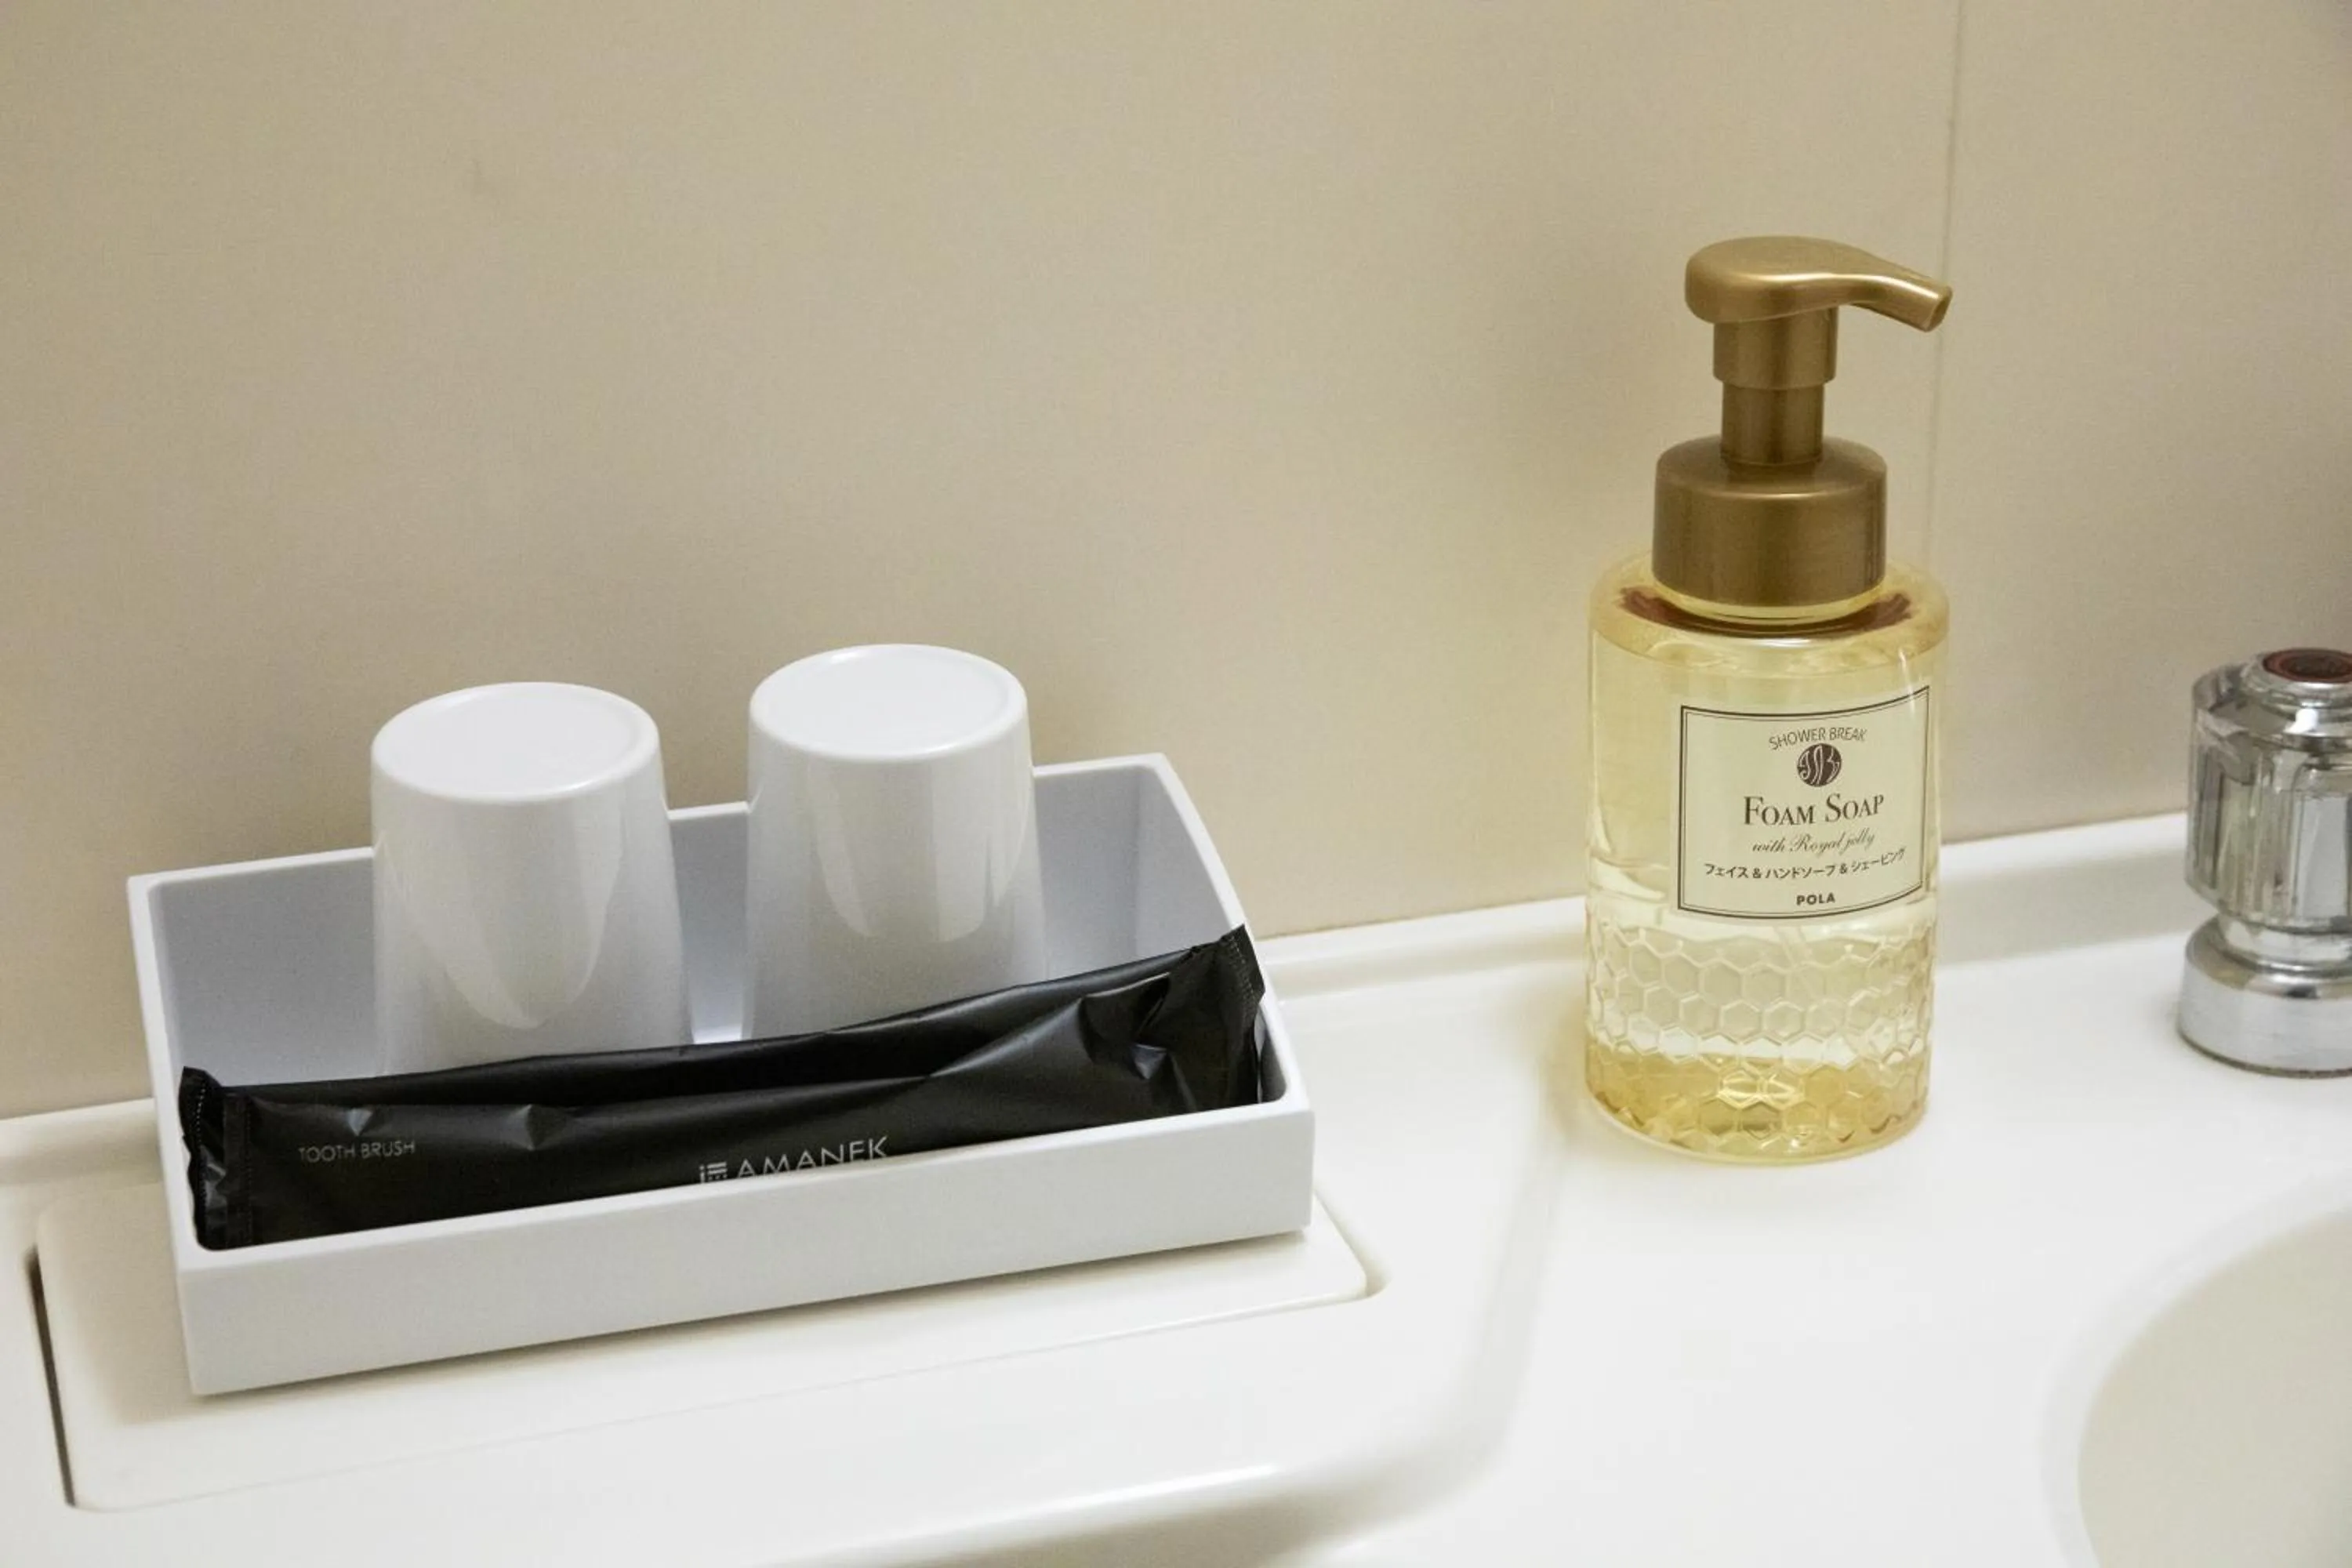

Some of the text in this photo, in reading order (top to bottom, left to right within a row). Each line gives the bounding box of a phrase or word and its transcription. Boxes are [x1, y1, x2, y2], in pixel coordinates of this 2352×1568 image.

[1769, 727, 1867, 750] SHOWER BREAK
[1744, 793, 1884, 826] FOAM SOAP
[1752, 837, 1785, 853] with
[1788, 833, 1845, 856] Royal
[1796, 893, 1835, 906] POLA
[298, 1140, 415, 1163] TOOTH BRUSH
